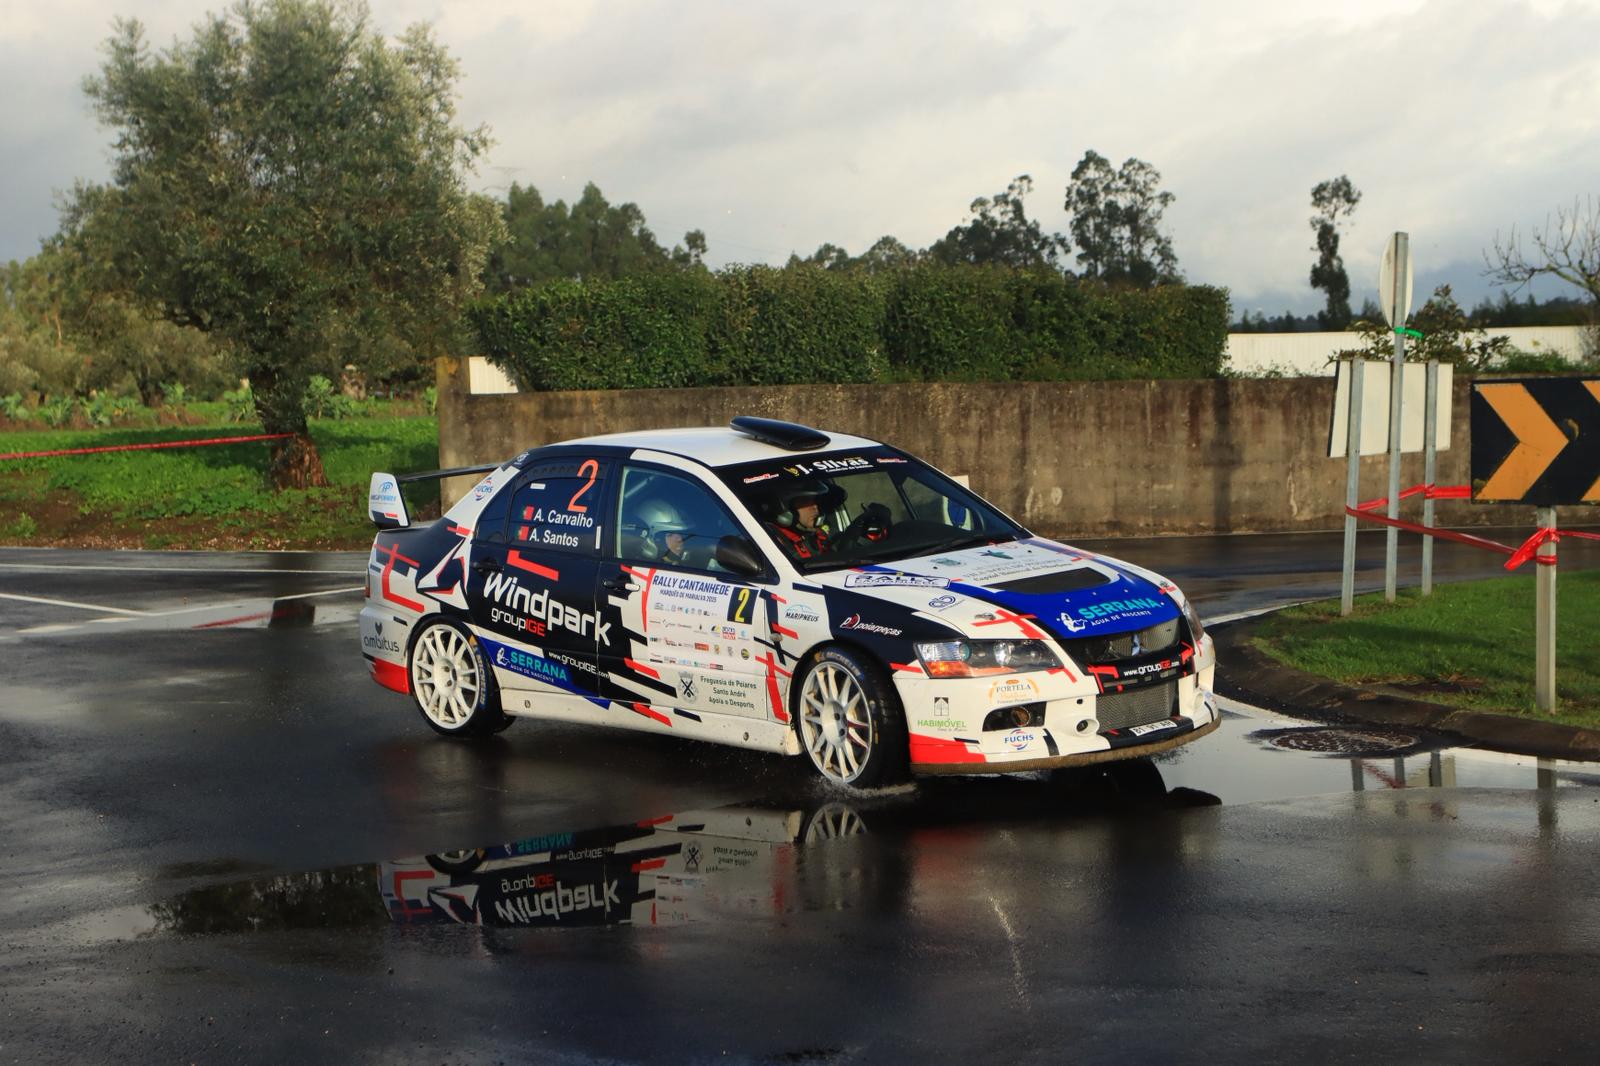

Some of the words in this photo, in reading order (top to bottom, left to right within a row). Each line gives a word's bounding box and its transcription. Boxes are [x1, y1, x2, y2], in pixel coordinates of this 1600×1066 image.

[812, 459, 869, 470] Silvas
[566, 458, 599, 513] 2
[533, 508, 545, 522] A.
[547, 510, 593, 528] Carvalho
[529, 529, 540, 543] A.
[543, 531, 579, 548] Santos
[652, 574, 679, 589] RALLY
[678, 578, 731, 597] CANTANHEDE
[483, 571, 612, 647] Windpark
[734, 587, 751, 623] 2
[1078, 597, 1161, 620] SERRANA
[1121, 610, 1152, 618] NASCENTE
[491, 607, 546, 637] groupIGE
[785, 612, 819, 622] MARIPNEUS
[855, 622, 903, 636] poiarpeças
[363, 632, 400, 654] ambitus
[510, 651, 568, 682] SERRANA
[548, 651, 610, 680] www.groupIGE.com
[700, 675, 727, 686] Freguesia
[735, 680, 757, 689] Poiares
[713, 687, 729, 696] Santo
[996, 683, 1032, 694] PORTELA
[709, 696, 724, 704] Apoia
[729, 699, 755, 710] Desporto
[917, 718, 967, 729] HABIMÓVEL
[1004, 734, 1034, 744] FUCHS
